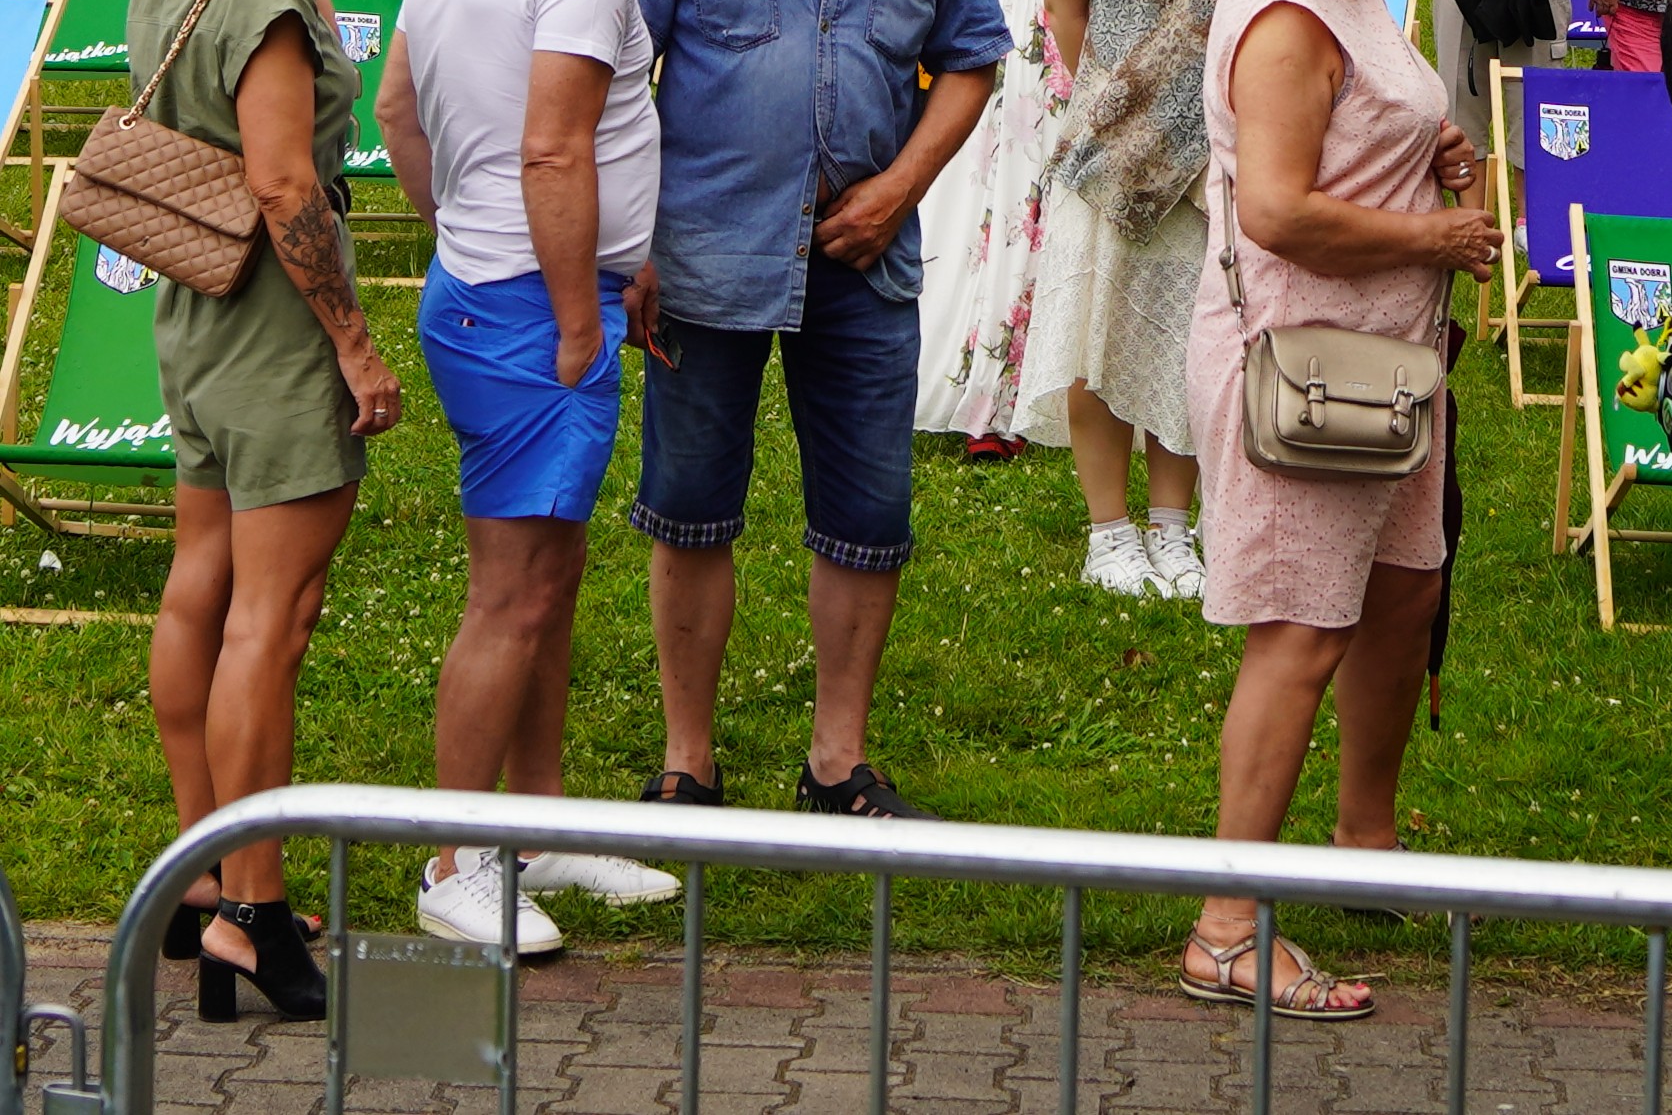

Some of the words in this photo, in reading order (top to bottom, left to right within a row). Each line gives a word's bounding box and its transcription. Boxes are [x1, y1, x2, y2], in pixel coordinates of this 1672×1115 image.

[1542, 108, 1563, 117] GMINA
[1564, 109, 1587, 118] DOBRA
[1612, 265, 1638, 276] GMINA
[1640, 267, 1667, 278] DOBRA
[50, 413, 172, 451] Wyjąt
